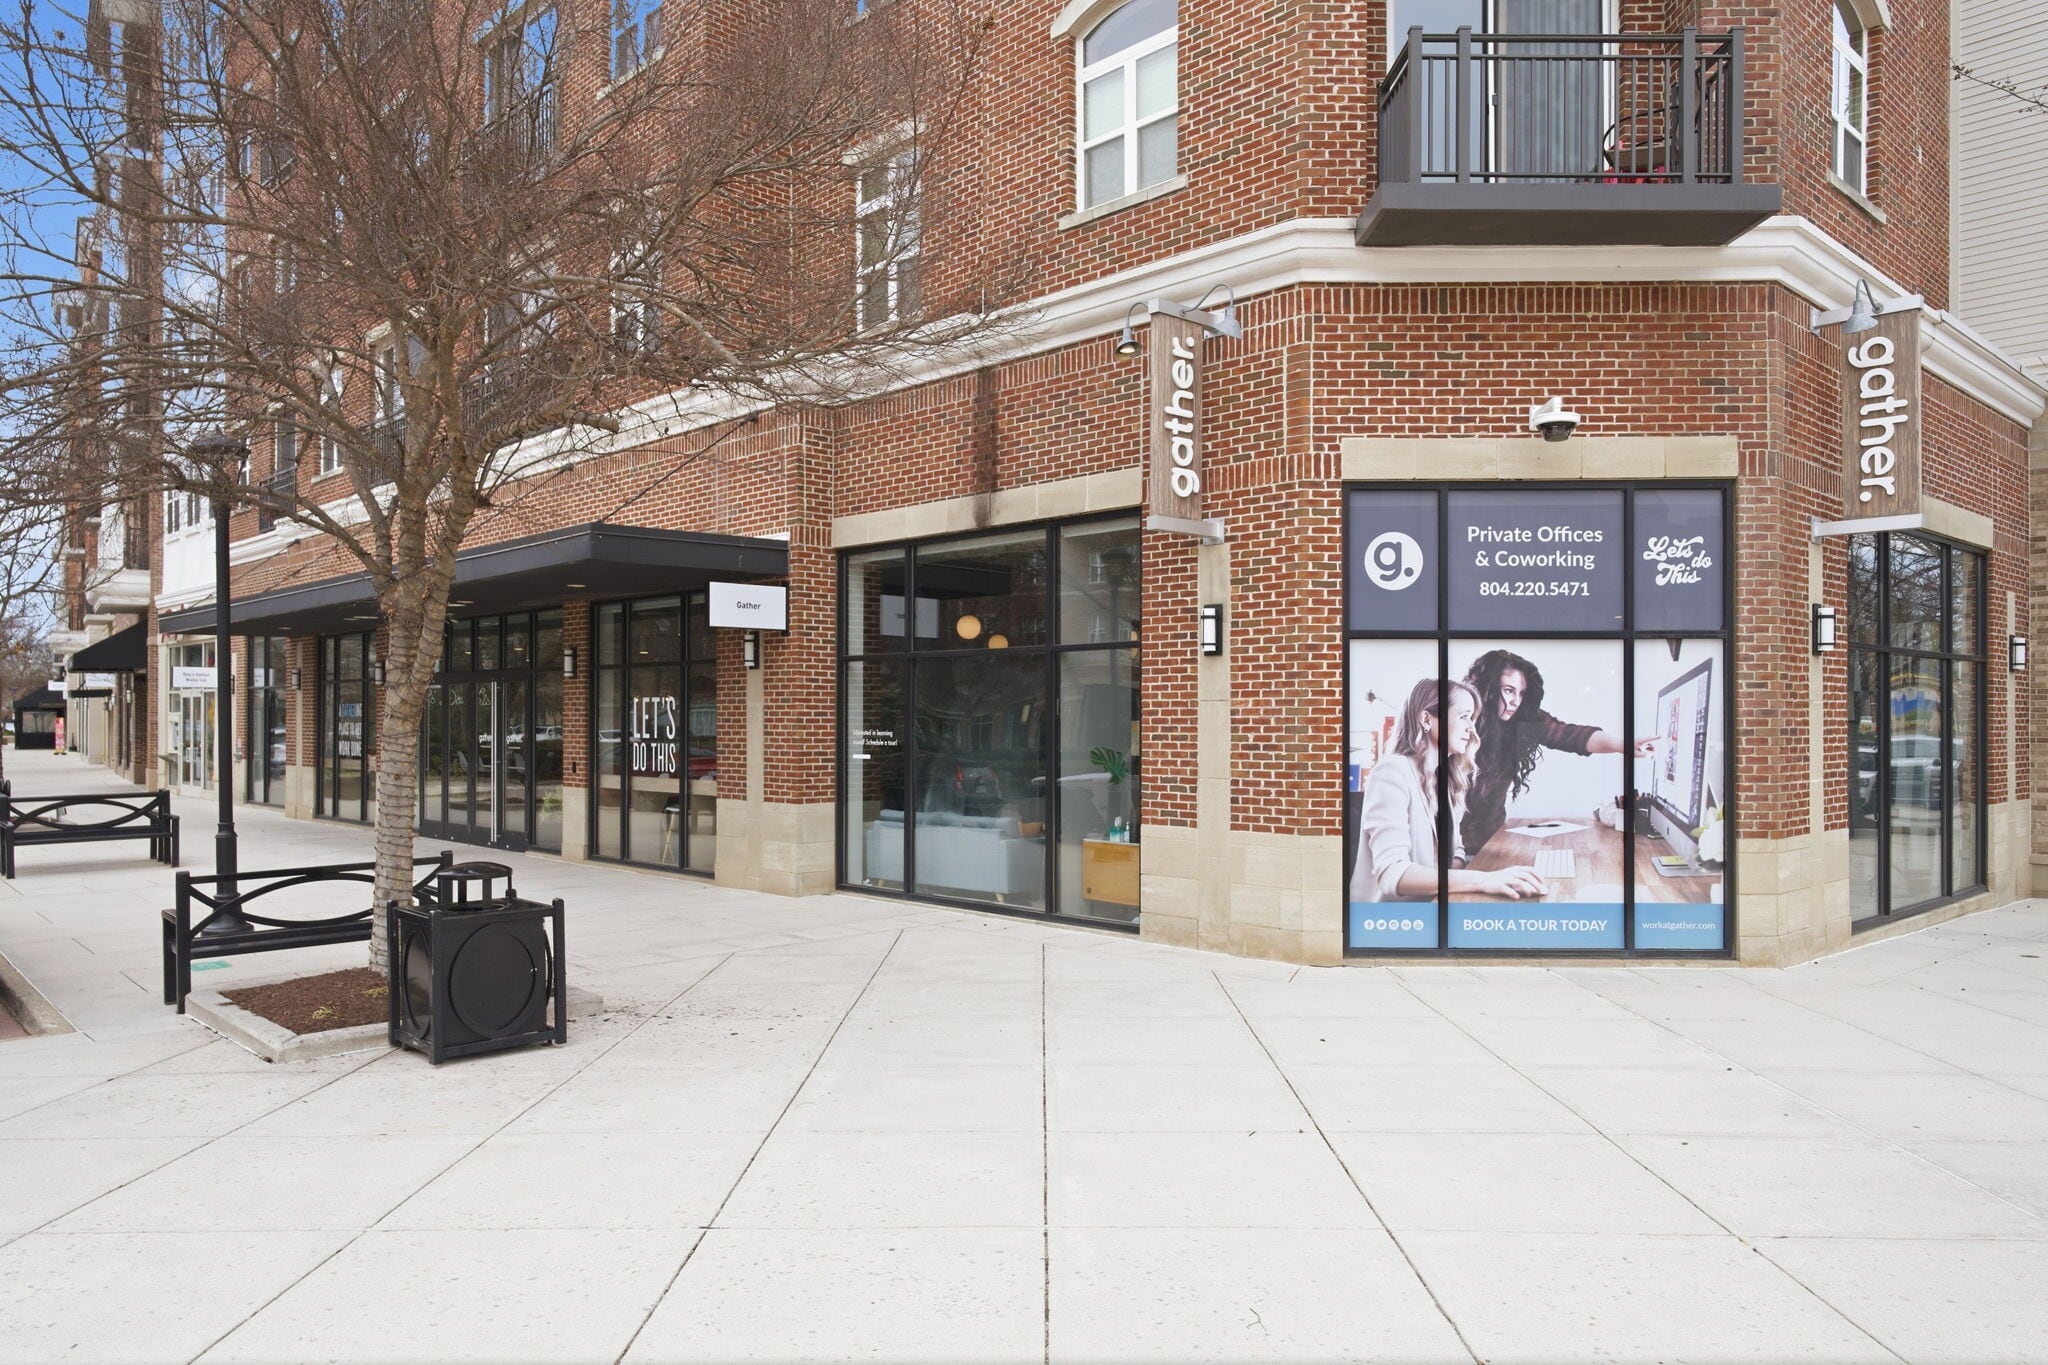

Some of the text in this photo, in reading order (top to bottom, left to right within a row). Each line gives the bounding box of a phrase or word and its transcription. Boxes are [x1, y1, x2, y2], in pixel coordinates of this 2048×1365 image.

[1164, 335, 1200, 498] gather.
[1847, 336, 1909, 502] gather.
[1467, 526, 1603, 542] Private Offices
[1475, 550, 1595, 570] & Coworking
[1691, 549, 1712, 568] do
[1655, 562, 1701, 586] This
[1479, 582, 1590, 597] 804.220.5471
[736, 600, 761, 610] Gather
[633, 696, 676, 739] LET'S
[865, 738, 883, 746] Schedule
[633, 742, 676, 773] DO THIS
[1463, 919, 1608, 932] BOOK A TOUR TODAY
[1642, 921, 1716, 931] workatgather.com
